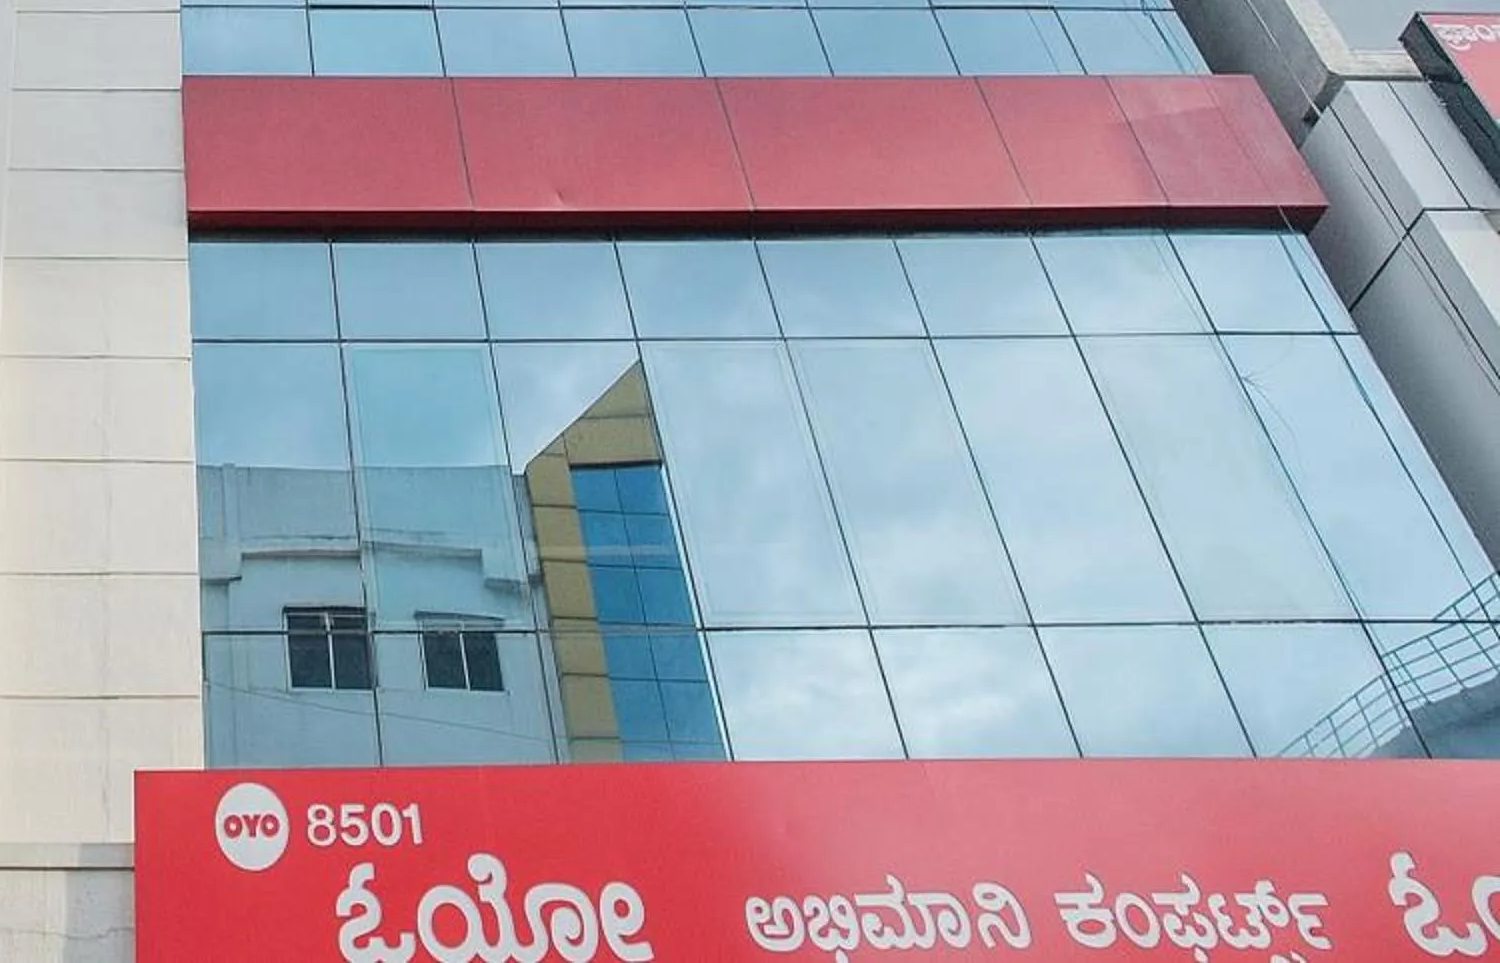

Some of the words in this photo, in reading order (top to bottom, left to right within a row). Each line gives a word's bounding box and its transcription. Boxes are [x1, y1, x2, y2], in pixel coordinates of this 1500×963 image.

[223, 812, 281, 838] OYO
[306, 802, 424, 847] 8501
[335, 852, 655, 963] ಓಯೋ
[744, 873, 1032, 963] ಅಭಿಮಾನಿ
[1053, 871, 1333, 963] ಕಂಫರ್ಟ್್
[1387, 851, 1500, 963] ಓ
